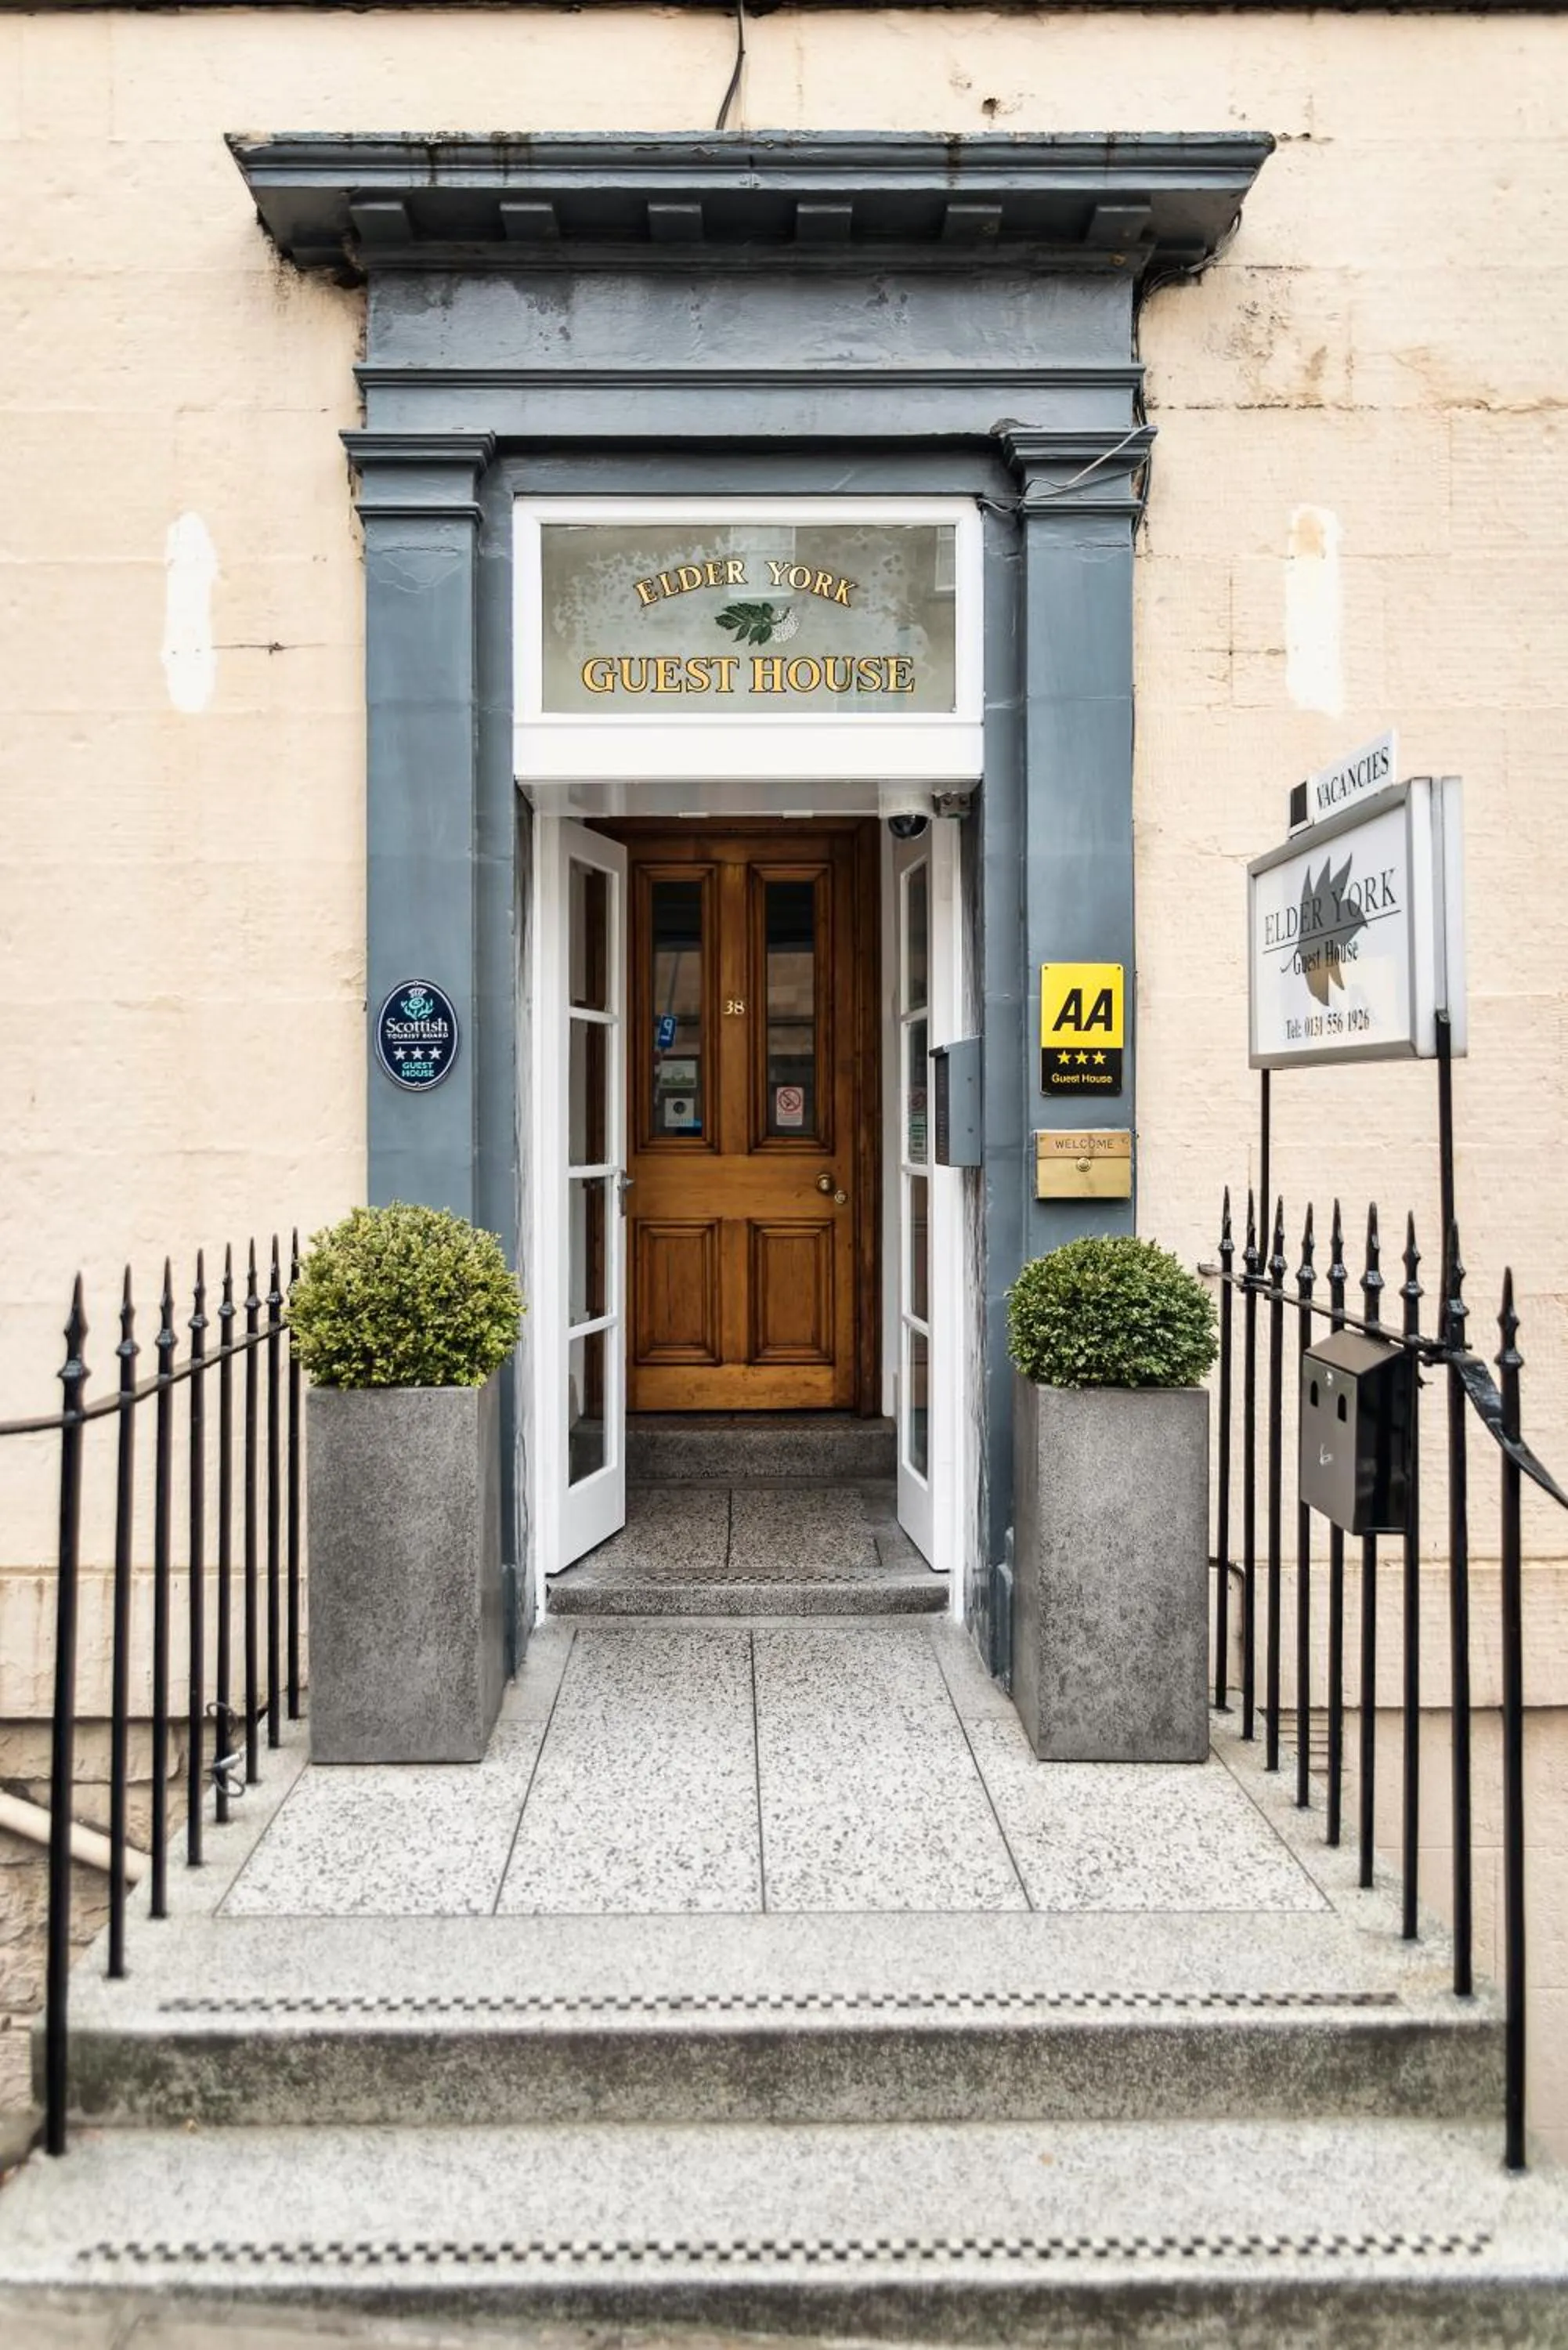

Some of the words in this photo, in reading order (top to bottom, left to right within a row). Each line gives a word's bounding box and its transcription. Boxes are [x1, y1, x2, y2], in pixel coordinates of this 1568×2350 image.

[632, 559, 748, 609] ELDER
[764, 560, 858, 608] YORK
[580, 656, 740, 694] GUEST
[749, 656, 916, 694] HOUSE
[1317, 746, 1389, 810] VACANCIES
[1265, 897, 1323, 945] ELDER
[1331, 868, 1397, 923] YORK
[1292, 950, 1321, 975] Guest
[1324, 939, 1359, 967] House
[385, 1018, 448, 1033] Scottish
[722, 1000, 745, 1015] 38
[1052, 989, 1113, 1032] AA
[1327, 1013, 1343, 1035] 556
[1052, 1073, 1080, 1083] Guest
[1082, 1074, 1113, 1083] House
[1055, 1139, 1114, 1149] WELCOME
